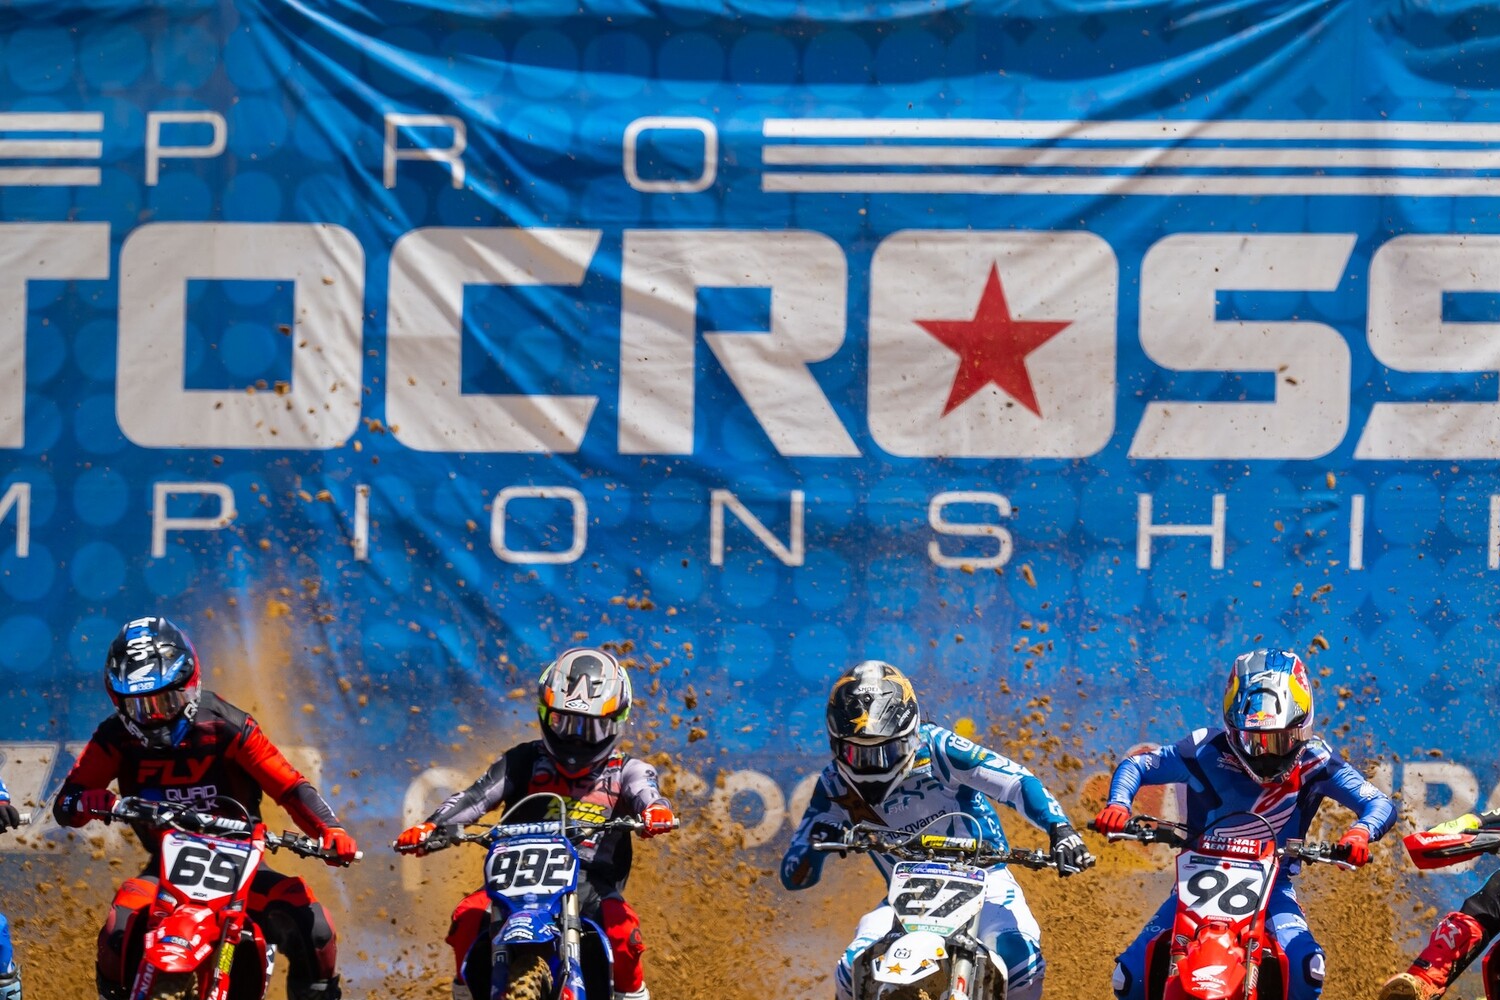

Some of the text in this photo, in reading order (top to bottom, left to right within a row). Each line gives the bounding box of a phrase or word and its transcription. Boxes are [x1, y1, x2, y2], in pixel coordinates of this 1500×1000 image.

[145, 111, 719, 193] PRO
[137, 755, 215, 785] FLY
[165, 785, 217, 801] QUAD
[488, 847, 576, 891] 992
[1202, 842, 1256, 854] RENTHAL
[168, 846, 248, 893] 69
[895, 877, 985, 918] 27
[1186, 869, 1260, 916] 96
